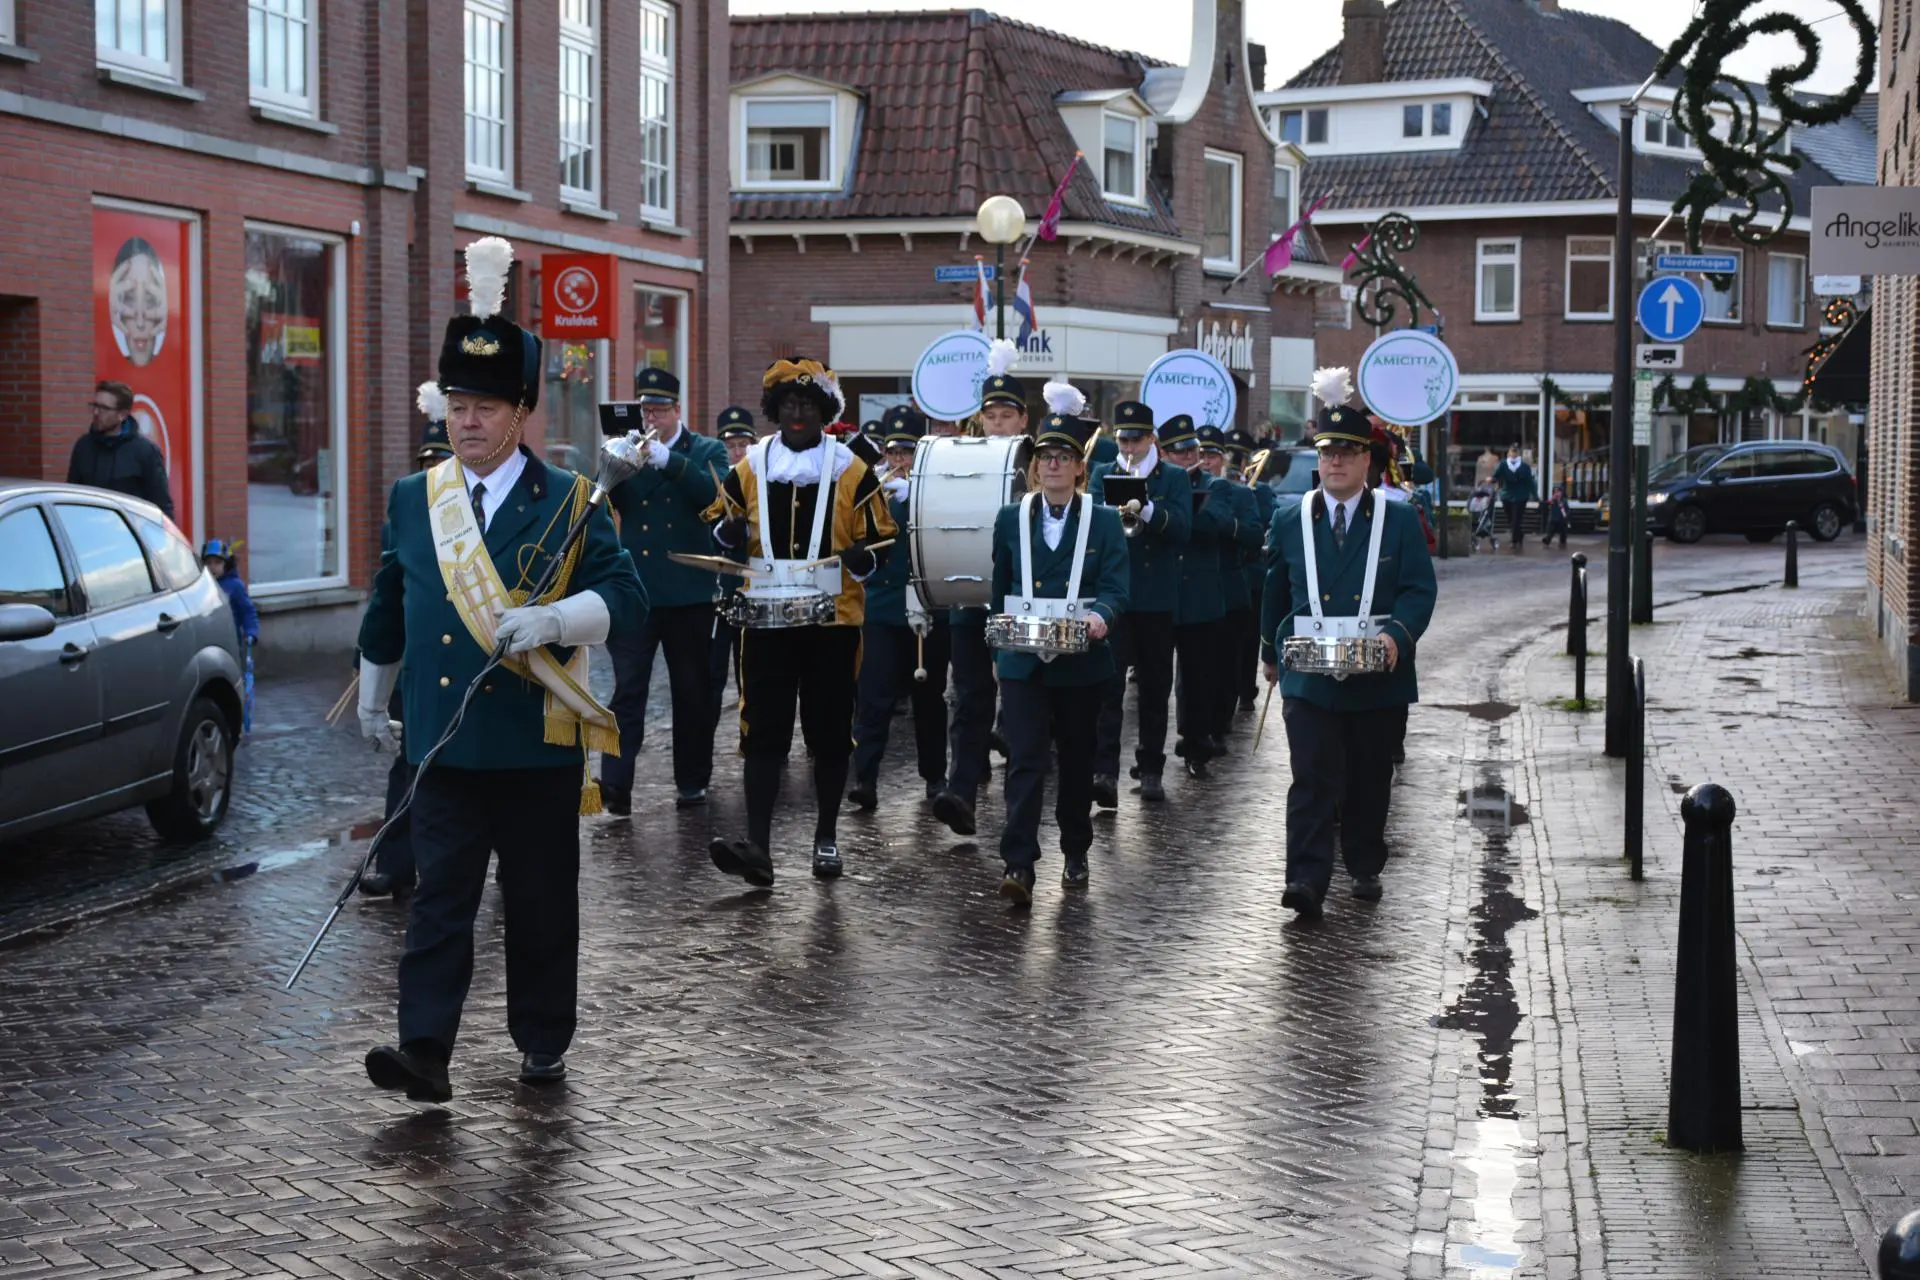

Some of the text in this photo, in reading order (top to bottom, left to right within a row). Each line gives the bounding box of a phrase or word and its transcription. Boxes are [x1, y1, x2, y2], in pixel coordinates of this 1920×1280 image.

[1825, 212, 1920, 249] Angelik
[1663, 258, 1731, 270] Noorderhagen
[555, 314, 598, 327] Kruidvat
[926, 350, 985, 366] AMICITIA
[1373, 356, 1438, 366] AMICITIA
[1154, 374, 1217, 387] AMICITIA
